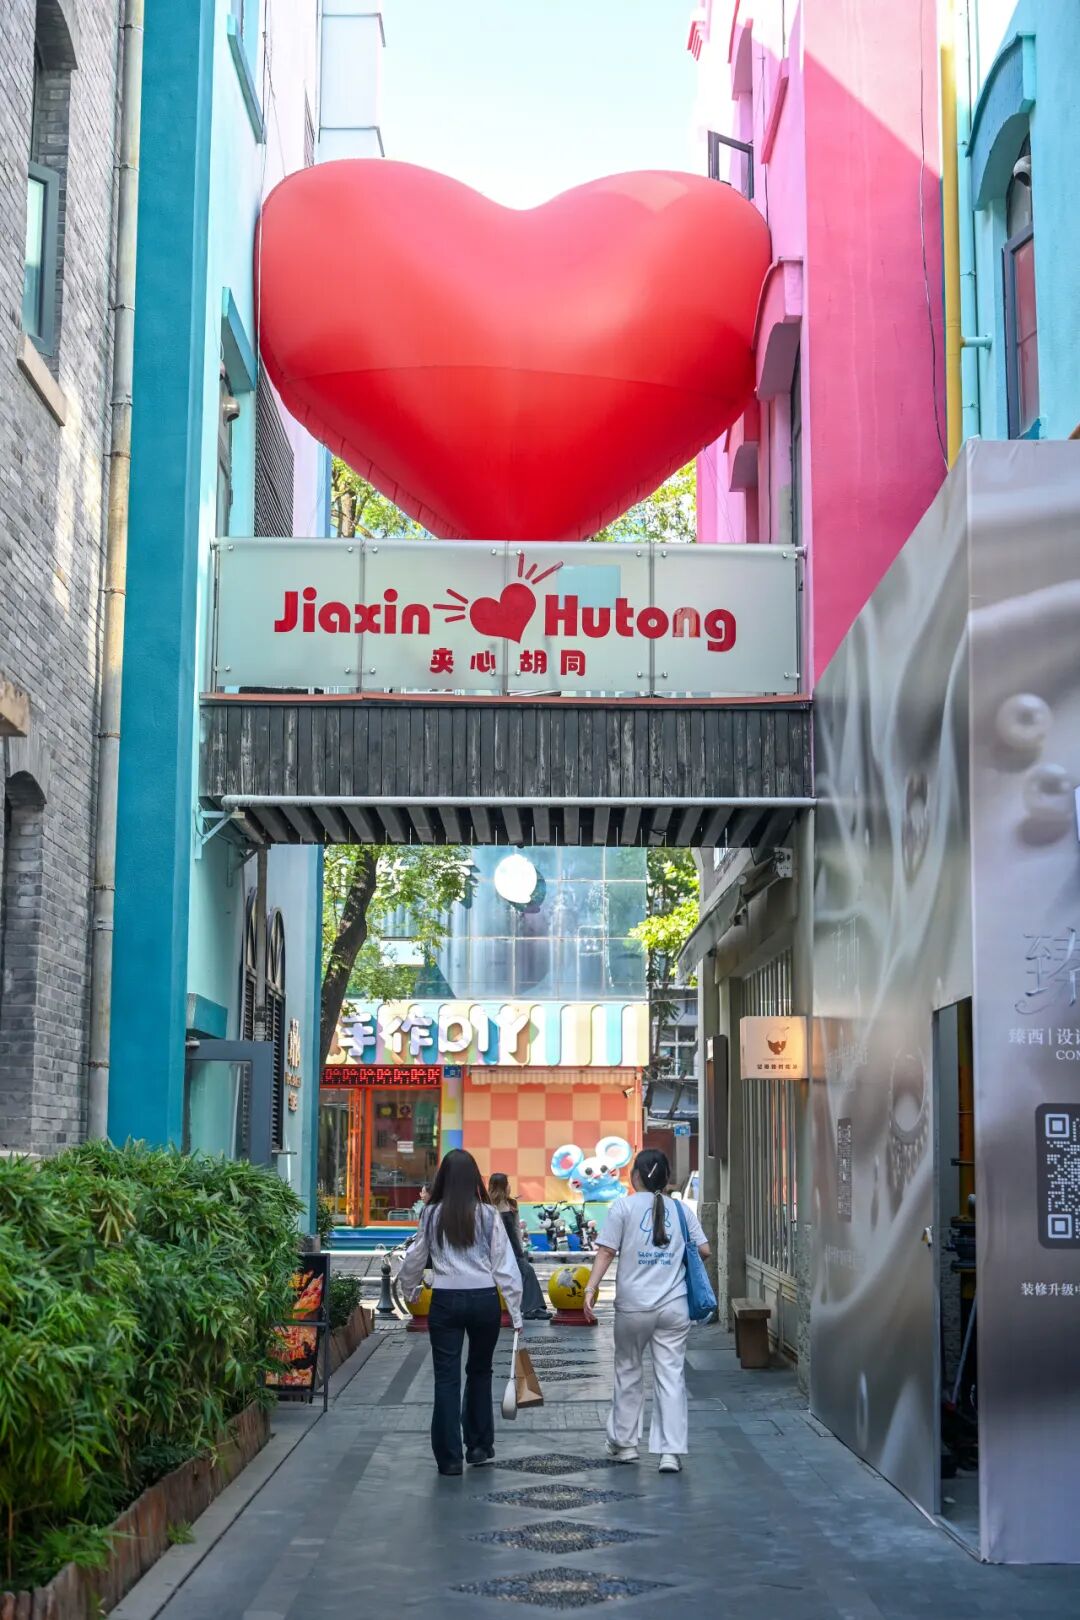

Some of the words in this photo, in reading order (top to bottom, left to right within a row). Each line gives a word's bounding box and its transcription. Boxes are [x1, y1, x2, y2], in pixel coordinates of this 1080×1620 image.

[274, 587, 430, 634] Jiaxin
[545, 594, 737, 652] Hutong
[430, 648, 586, 676] 夹心胡同
[338, 1006, 530, 1057] 手作DIY
